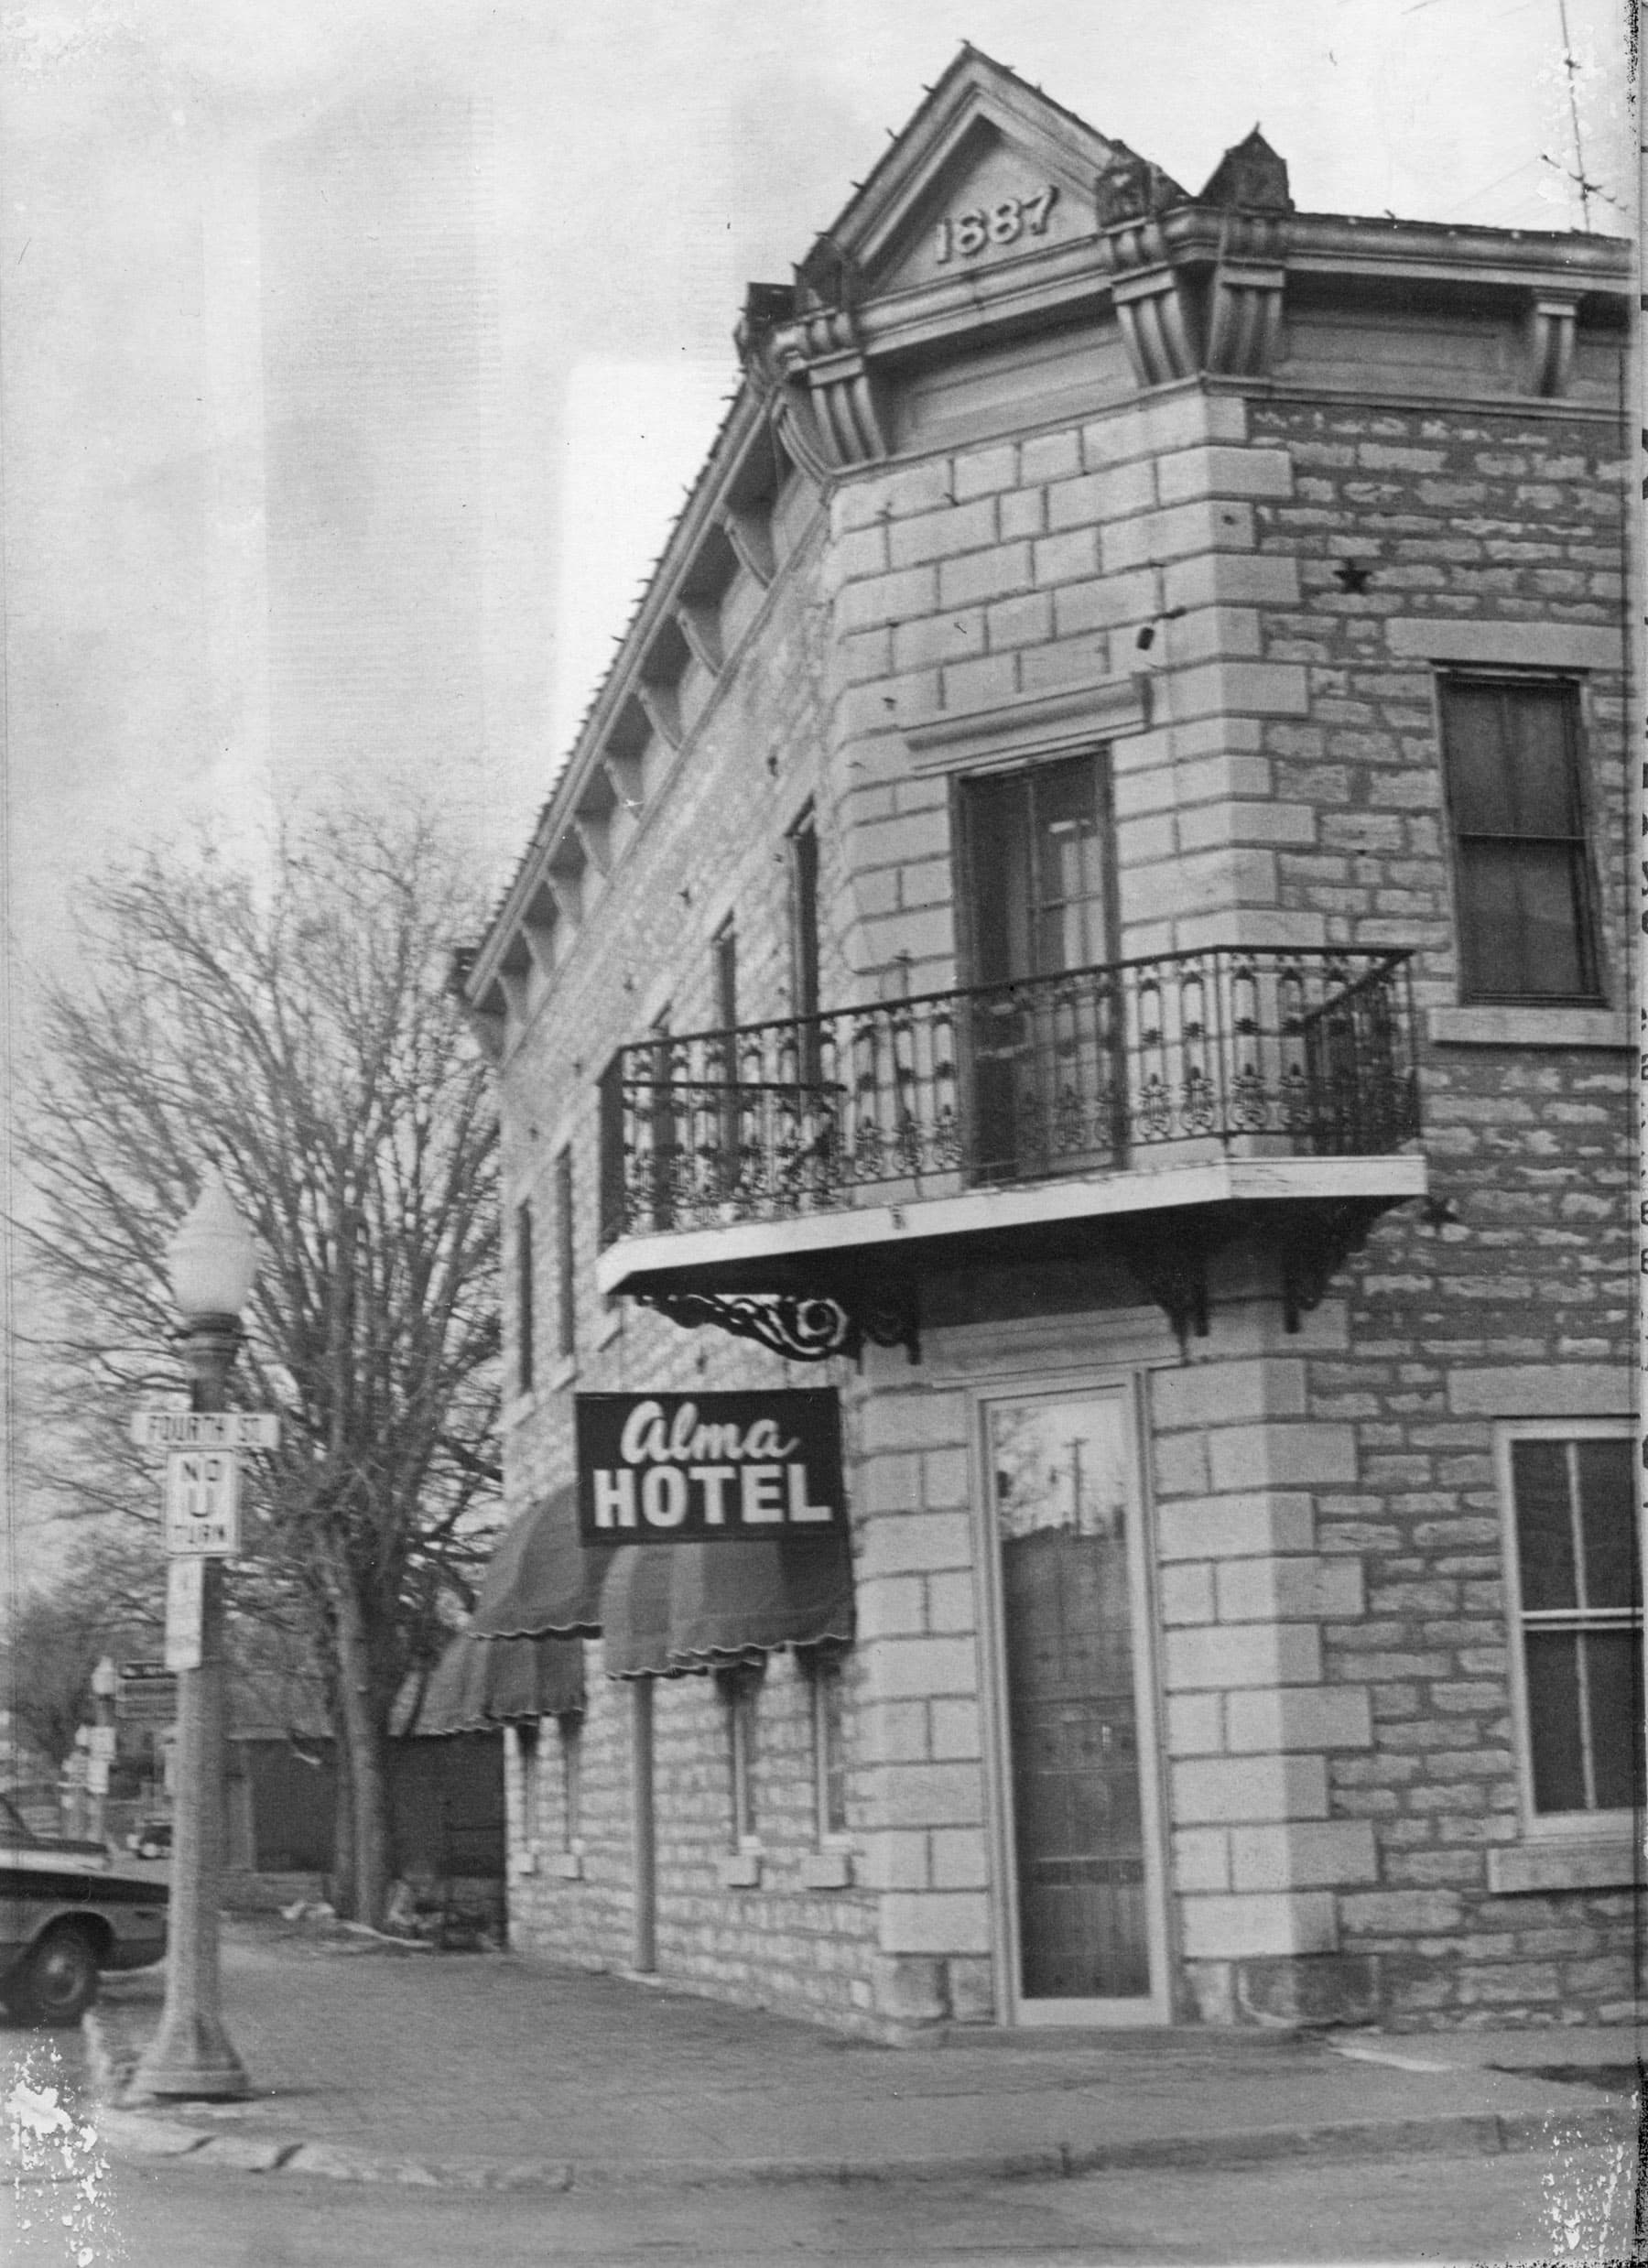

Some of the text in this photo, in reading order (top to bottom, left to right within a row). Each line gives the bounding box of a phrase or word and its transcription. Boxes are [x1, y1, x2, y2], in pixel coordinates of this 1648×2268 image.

[935, 182, 1060, 266] 1887
[147, 1415, 263, 1443] FOURTH ST
[620, 1400, 801, 1464] Alma
[180, 1458, 222, 1482] NO
[189, 1486, 214, 1520] U
[592, 1462, 834, 1528] HOTEL
[170, 1524, 228, 1546] TURN
